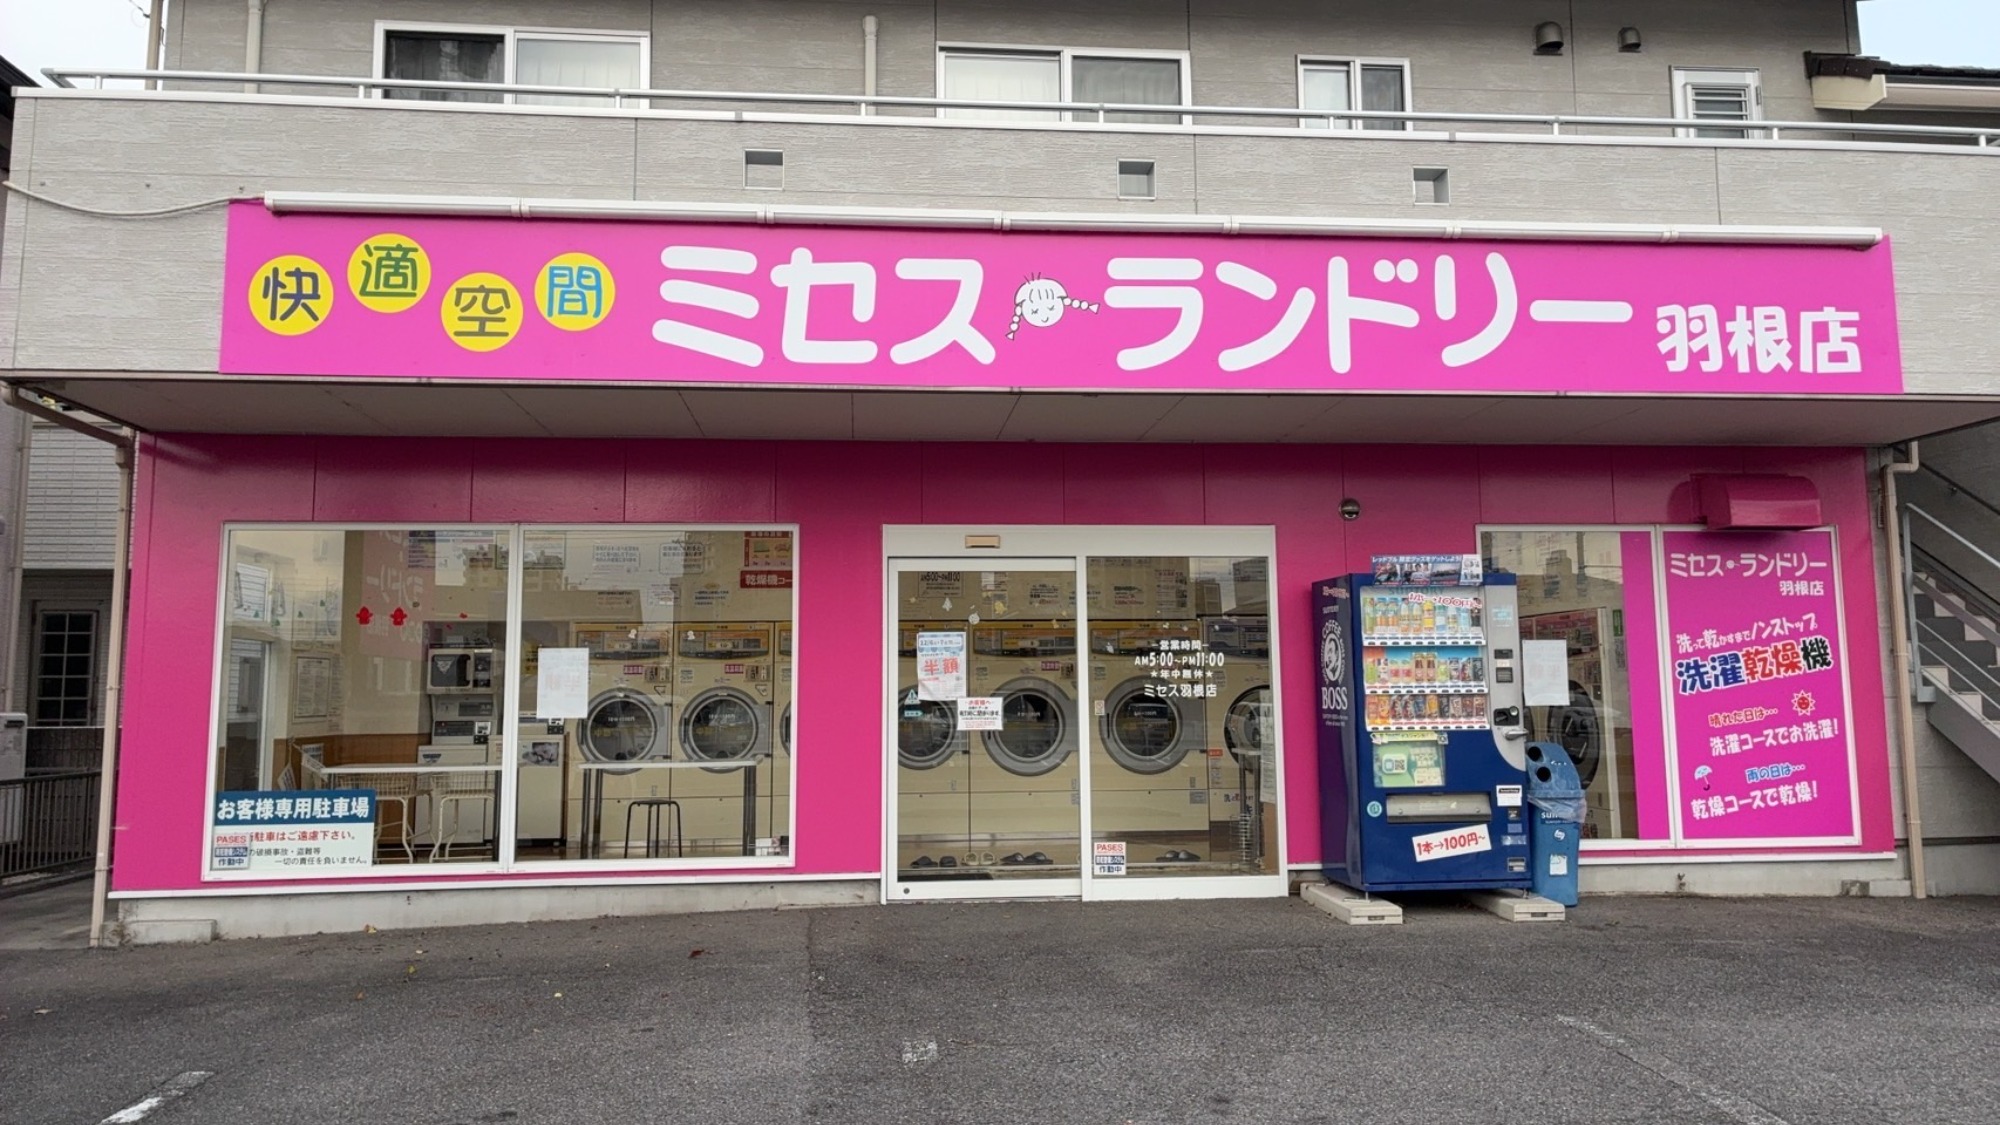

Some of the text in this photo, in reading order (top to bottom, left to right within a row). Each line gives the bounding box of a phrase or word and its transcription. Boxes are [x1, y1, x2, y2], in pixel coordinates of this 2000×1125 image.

[652, 245, 1861, 374] ミセス ランドリー 羽根店
[1670, 552, 1827, 577] ミセス ランドリー
[1779, 580, 1825, 596] 羽根店
[1676, 612, 1818, 654] 洗って乾かすまでノンストップ
[1677, 635, 1832, 694] 洗濯乾燥機
[1144, 684, 1218, 697] ミセス羽根店
[1321, 686, 1348, 710] BOSS
[1709, 718, 1839, 757] 洗濯コースでお洗濯!
[217, 796, 370, 820] お客様専用駐車場
[1690, 781, 1818, 820] 乾燥コースで乾燥!
[216, 835, 247, 844] PASES
[1096, 843, 1124, 852] PASES
